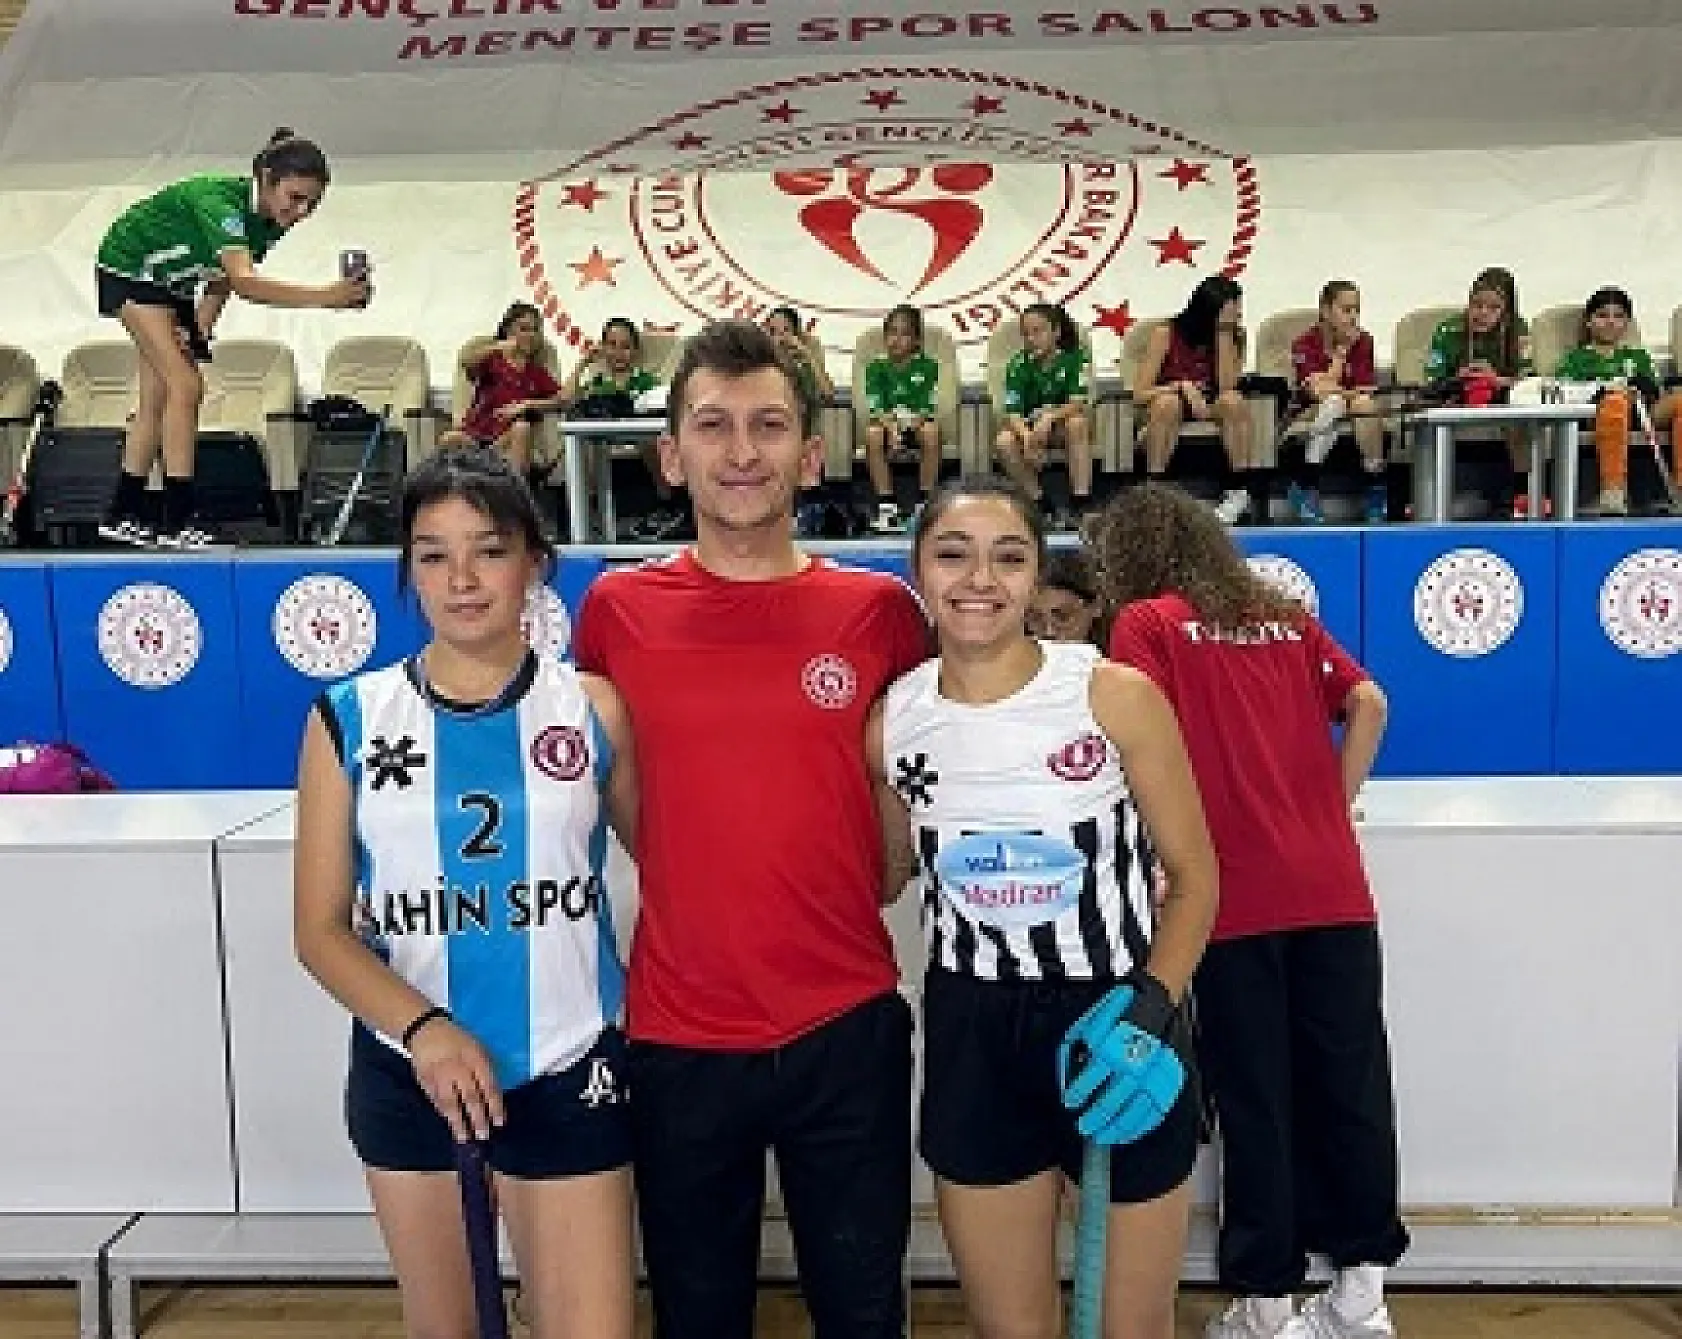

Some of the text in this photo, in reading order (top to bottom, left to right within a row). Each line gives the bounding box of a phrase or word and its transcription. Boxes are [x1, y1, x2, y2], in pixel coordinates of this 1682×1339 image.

[399, 3, 1380, 59] MENTEŞE SPOR SALONU
[457, 792, 505, 858] 2
[371, 873, 489, 936] AHİN
